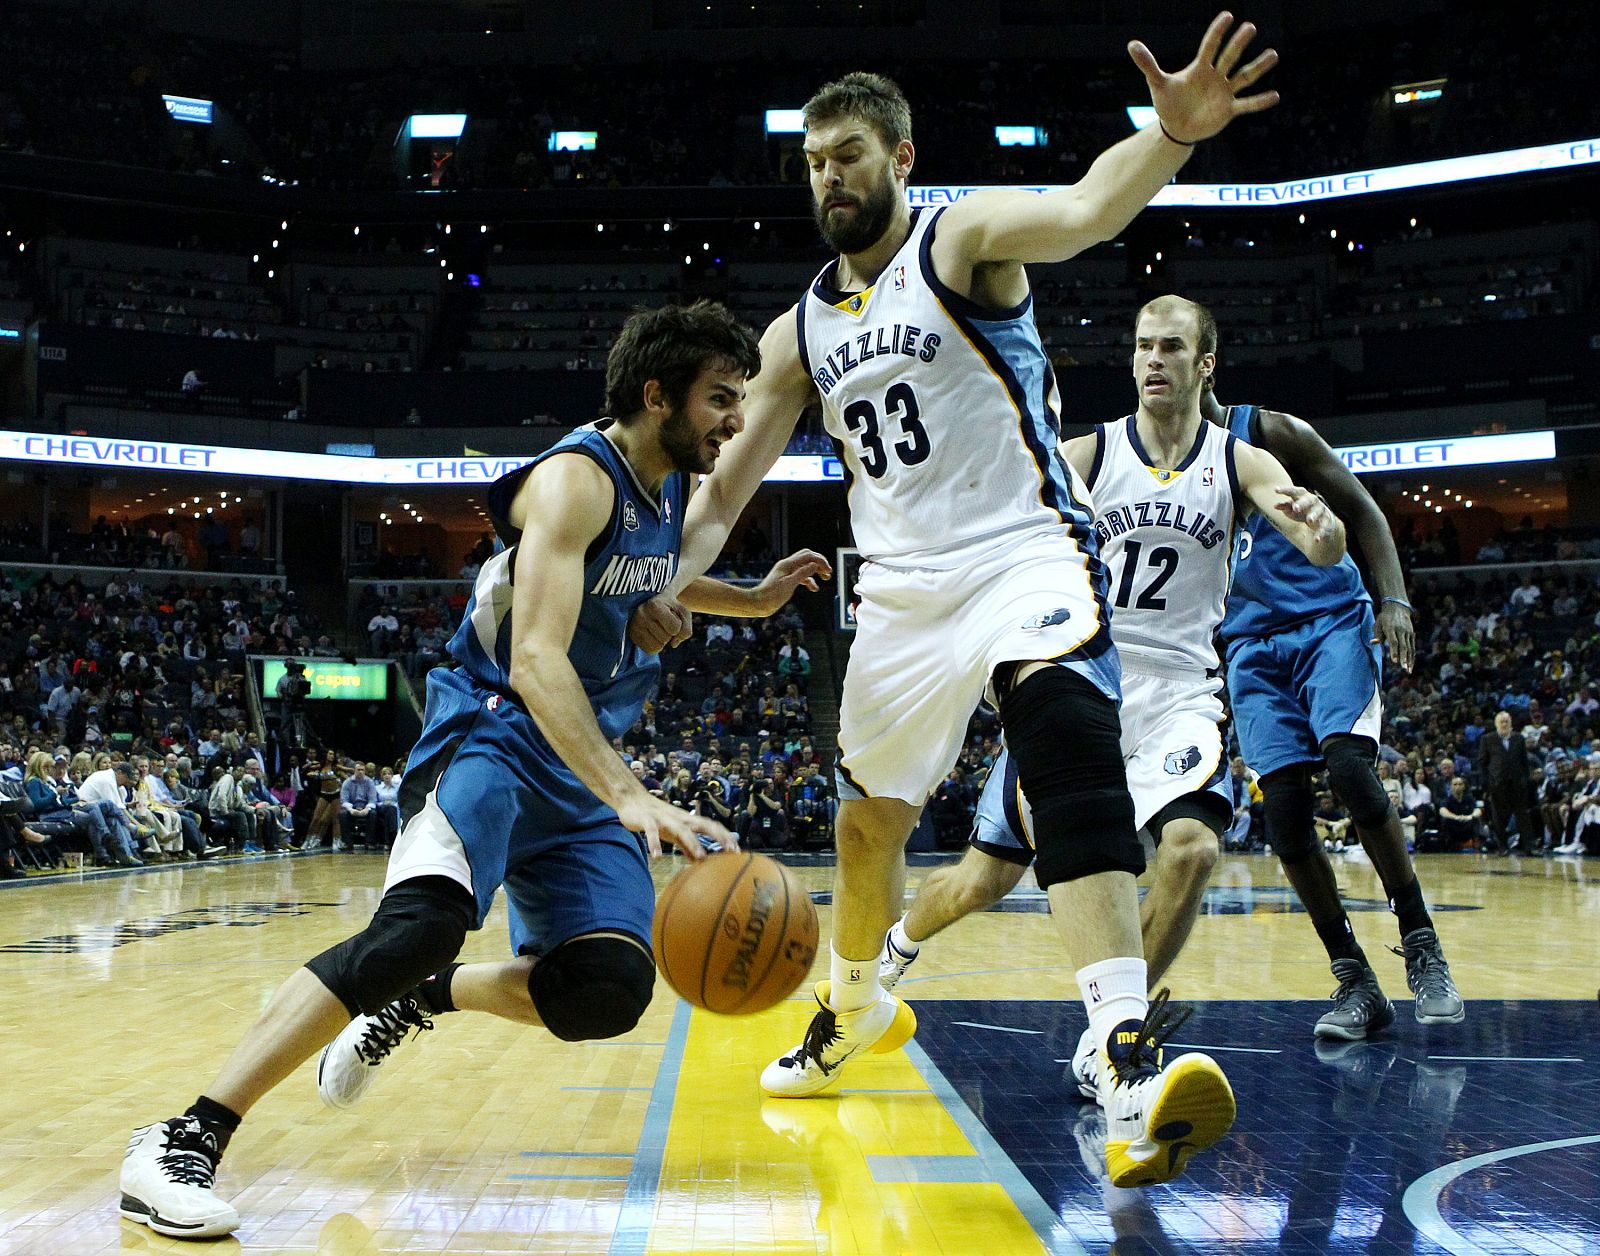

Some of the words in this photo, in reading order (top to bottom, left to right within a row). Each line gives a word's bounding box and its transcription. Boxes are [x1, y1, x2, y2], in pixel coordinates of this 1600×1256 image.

[1218, 173, 1375, 202] CHEVROLET
[814, 323, 941, 396] RIZZLIES
[843, 382, 931, 479] 33
[25, 436, 217, 467] CHEVROLET
[416, 461, 533, 479] CHEVR
[625, 506, 637, 522] 25
[1094, 501, 1225, 550] GRIZZLIES
[1114, 539, 1180, 611] 12
